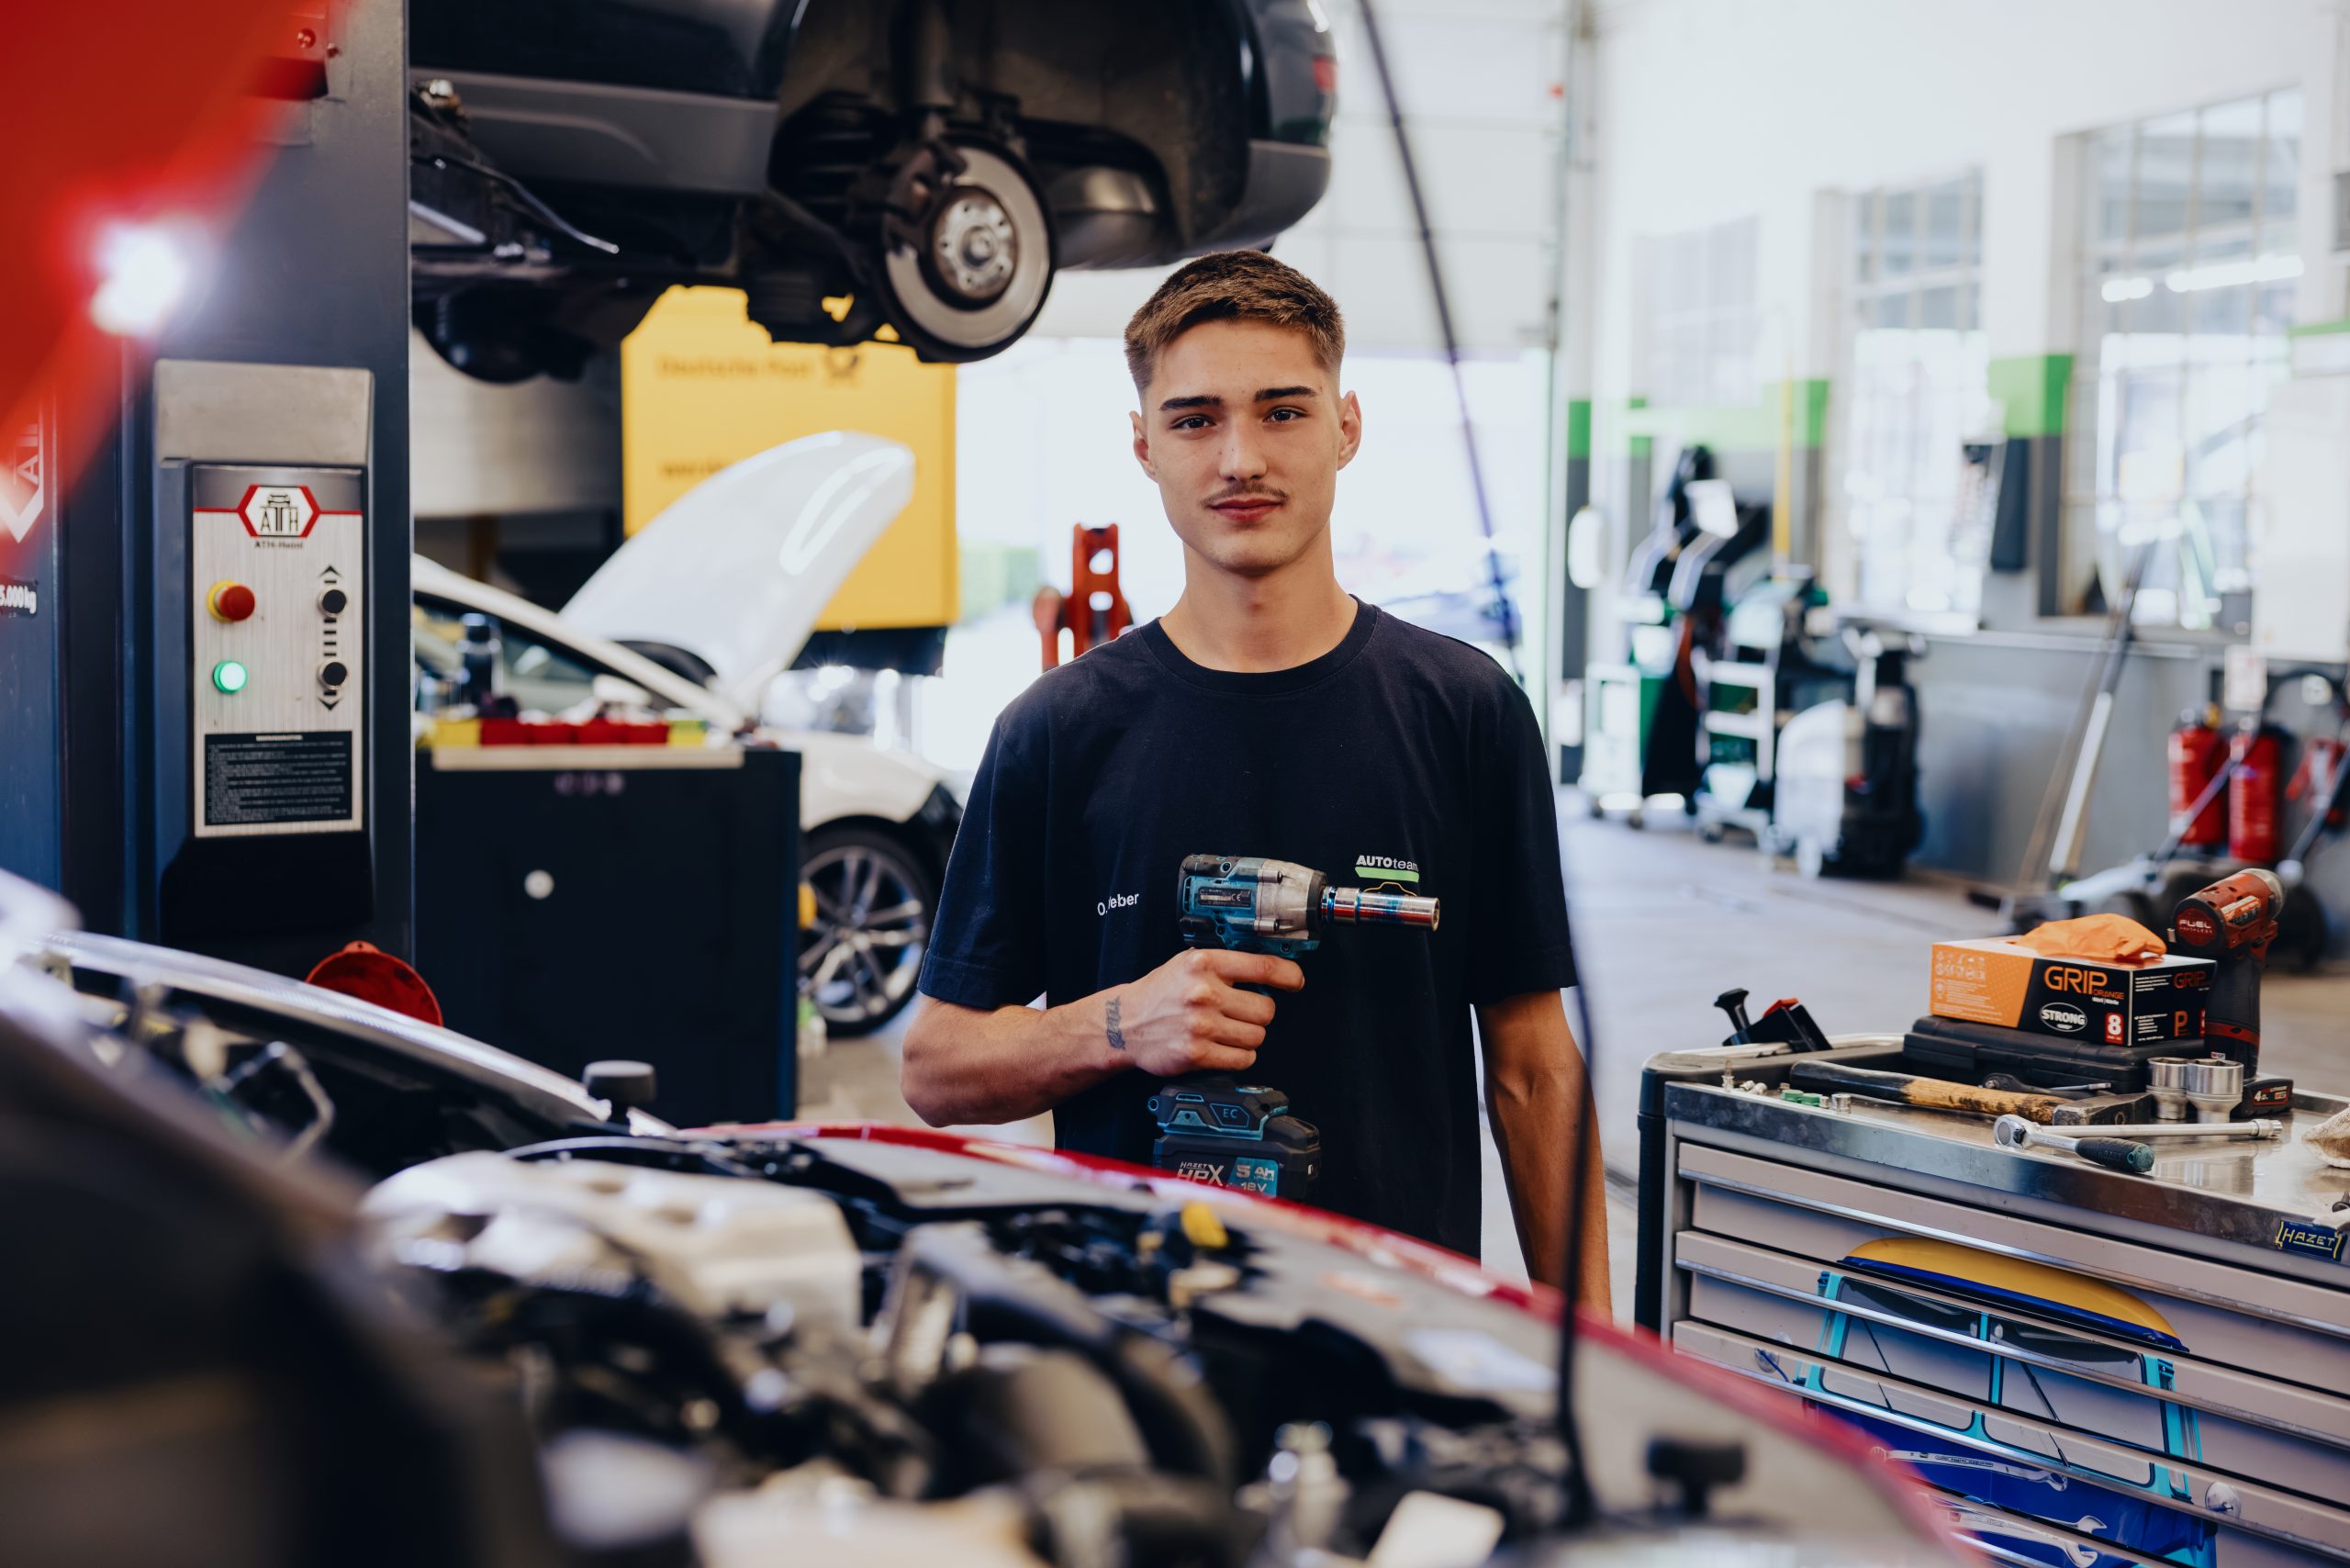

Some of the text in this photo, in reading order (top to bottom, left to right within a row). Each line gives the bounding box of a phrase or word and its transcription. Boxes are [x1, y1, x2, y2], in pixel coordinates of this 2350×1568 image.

[260, 506, 299, 532] ATH
[1108, 893, 1139, 910] eber
[2179, 919, 2212, 930] FUEL
[2043, 965, 2108, 995] GRIP
[2173, 970, 2207, 990] GRIP
[2093, 989, 2125, 1000] ORANGE
[2041, 1009, 2086, 1025] STRONG
[2107, 1014, 2122, 1036] 8
[1222, 1108, 1239, 1119] EC
[1180, 1160, 1208, 1169] HAZET
[1236, 1164, 1275, 1179] 5 Ah
[1176, 1163, 1225, 1187] HPX
[2282, 1227, 2335, 1247] HAZET
